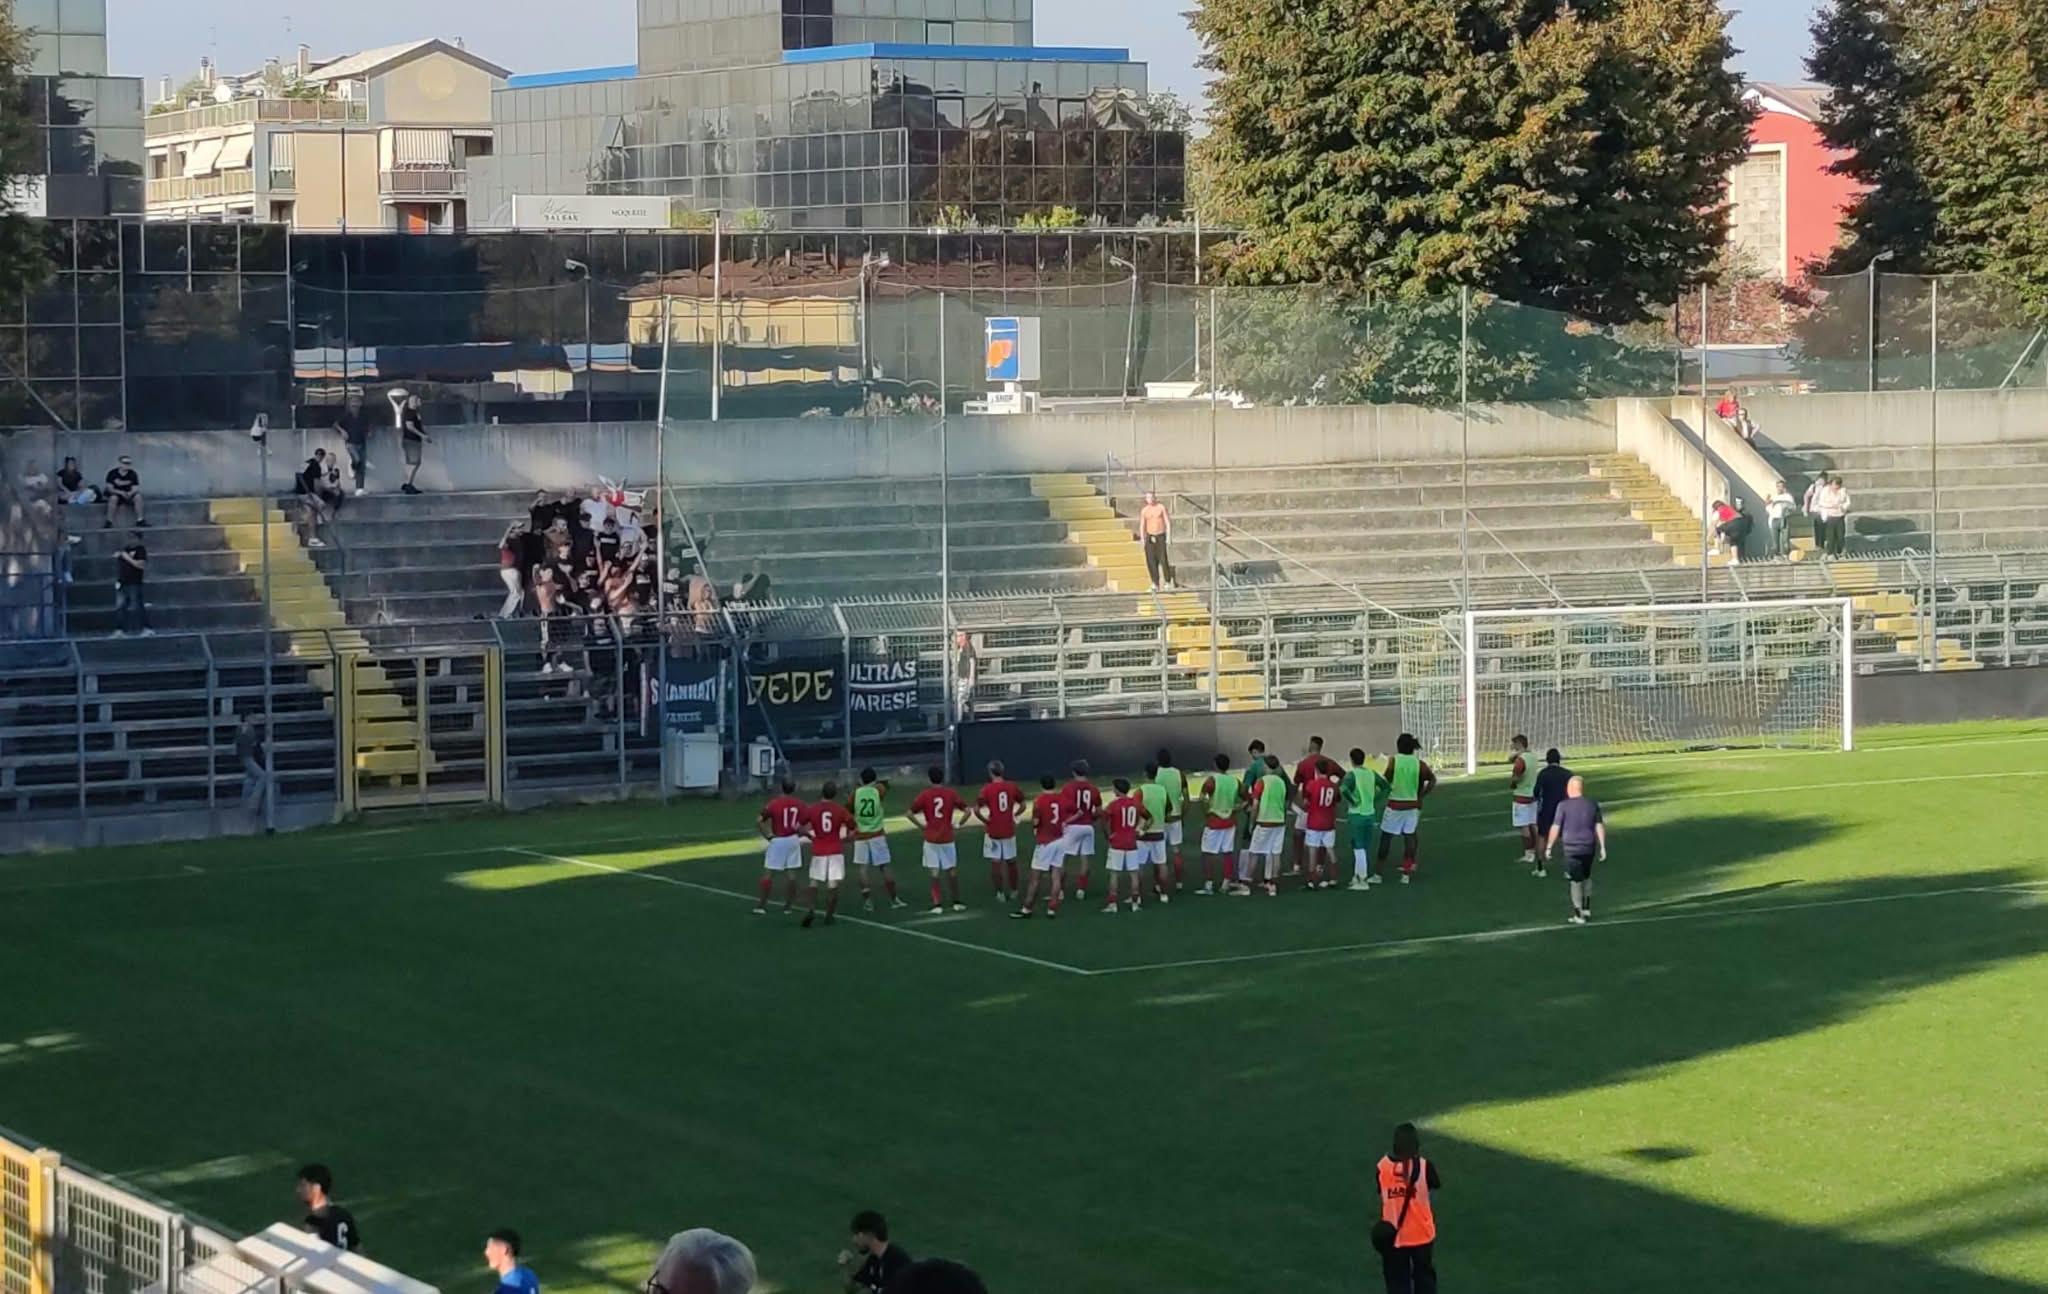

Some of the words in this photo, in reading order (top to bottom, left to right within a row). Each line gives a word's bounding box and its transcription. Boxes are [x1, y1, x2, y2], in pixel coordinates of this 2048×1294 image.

[1076, 789, 1091, 810] 19
[1319, 785, 1334, 807] 18
[860, 798, 875, 817] 23
[933, 796, 944, 818] 2
[1050, 803, 1059, 824] 3
[1121, 806, 1137, 827] 10
[783, 807, 799, 830] 17
[821, 811, 833, 832] 6
